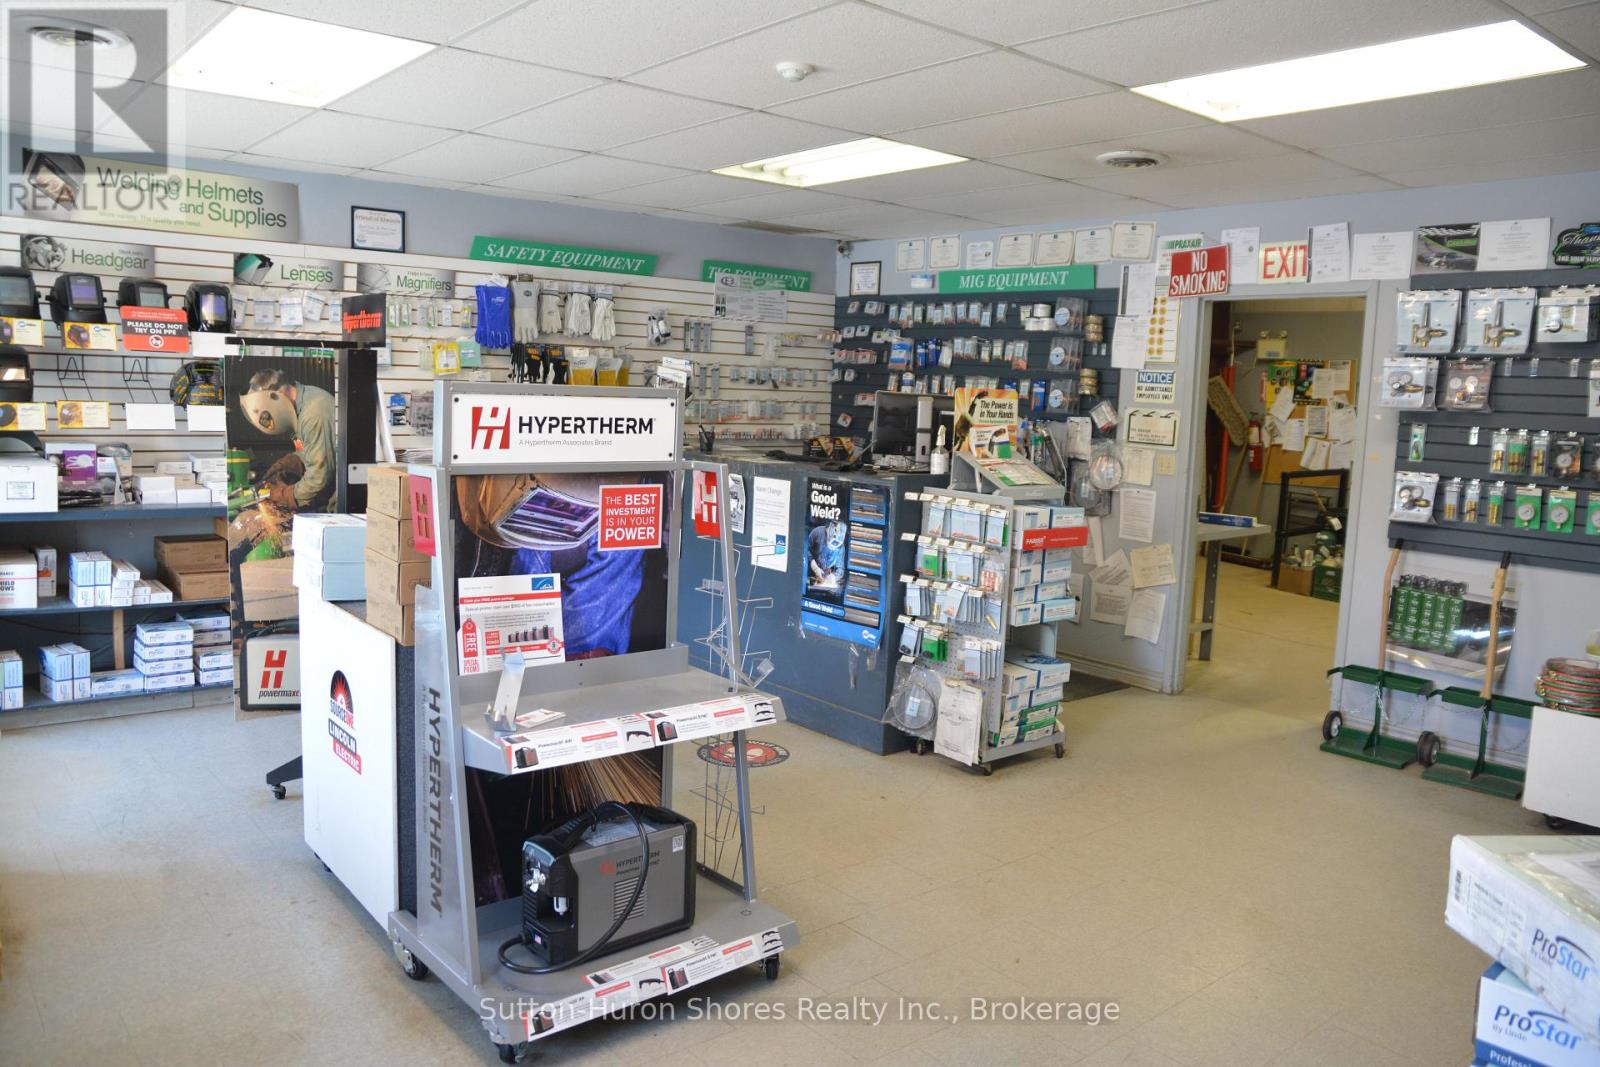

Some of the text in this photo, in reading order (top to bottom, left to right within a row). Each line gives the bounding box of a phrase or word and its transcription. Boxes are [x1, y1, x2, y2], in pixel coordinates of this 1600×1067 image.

[96, 166, 264, 206] Welding Helmets
[179, 201, 287, 229] and Supplies
[1175, 239, 1202, 249] PRAXAIR
[71, 248, 149, 271] Headgear
[484, 243, 646, 272] SAFETY EQUIPMENT
[1192, 250, 1208, 273] NO
[1263, 244, 1308, 280] EXIT
[281, 263, 334, 283] Lenses
[396, 274, 453, 292] Magnifiers
[959, 271, 1069, 290] MIG EQUIPMENT
[1170, 269, 1226, 296] SMOKING
[127, 320, 153, 328] PLEASE
[1139, 372, 1173, 383] NOTICE
[980, 400, 990, 409] The
[991, 401, 1007, 410] Power
[518, 415, 654, 435] HYPERTHERM
[525, 439, 561, 447] Hypertherm
[604, 493, 657, 506] THE BEST
[811, 490, 838, 506] Good
[606, 506, 656, 516] INVESTMENT
[810, 503, 841, 520] Weld?
[606, 516, 655, 527] IS IN YOUR
[605, 526, 656, 542] POWER
[464, 632, 477, 653] FREE
[329, 720, 357, 753] LINCOLN
[335, 741, 361, 772] ELECTRIC
[428, 687, 442, 914] HYPERTHERM
[1532, 928, 1590, 982] ProStar
[1494, 1004, 1585, 1050] ProStar
